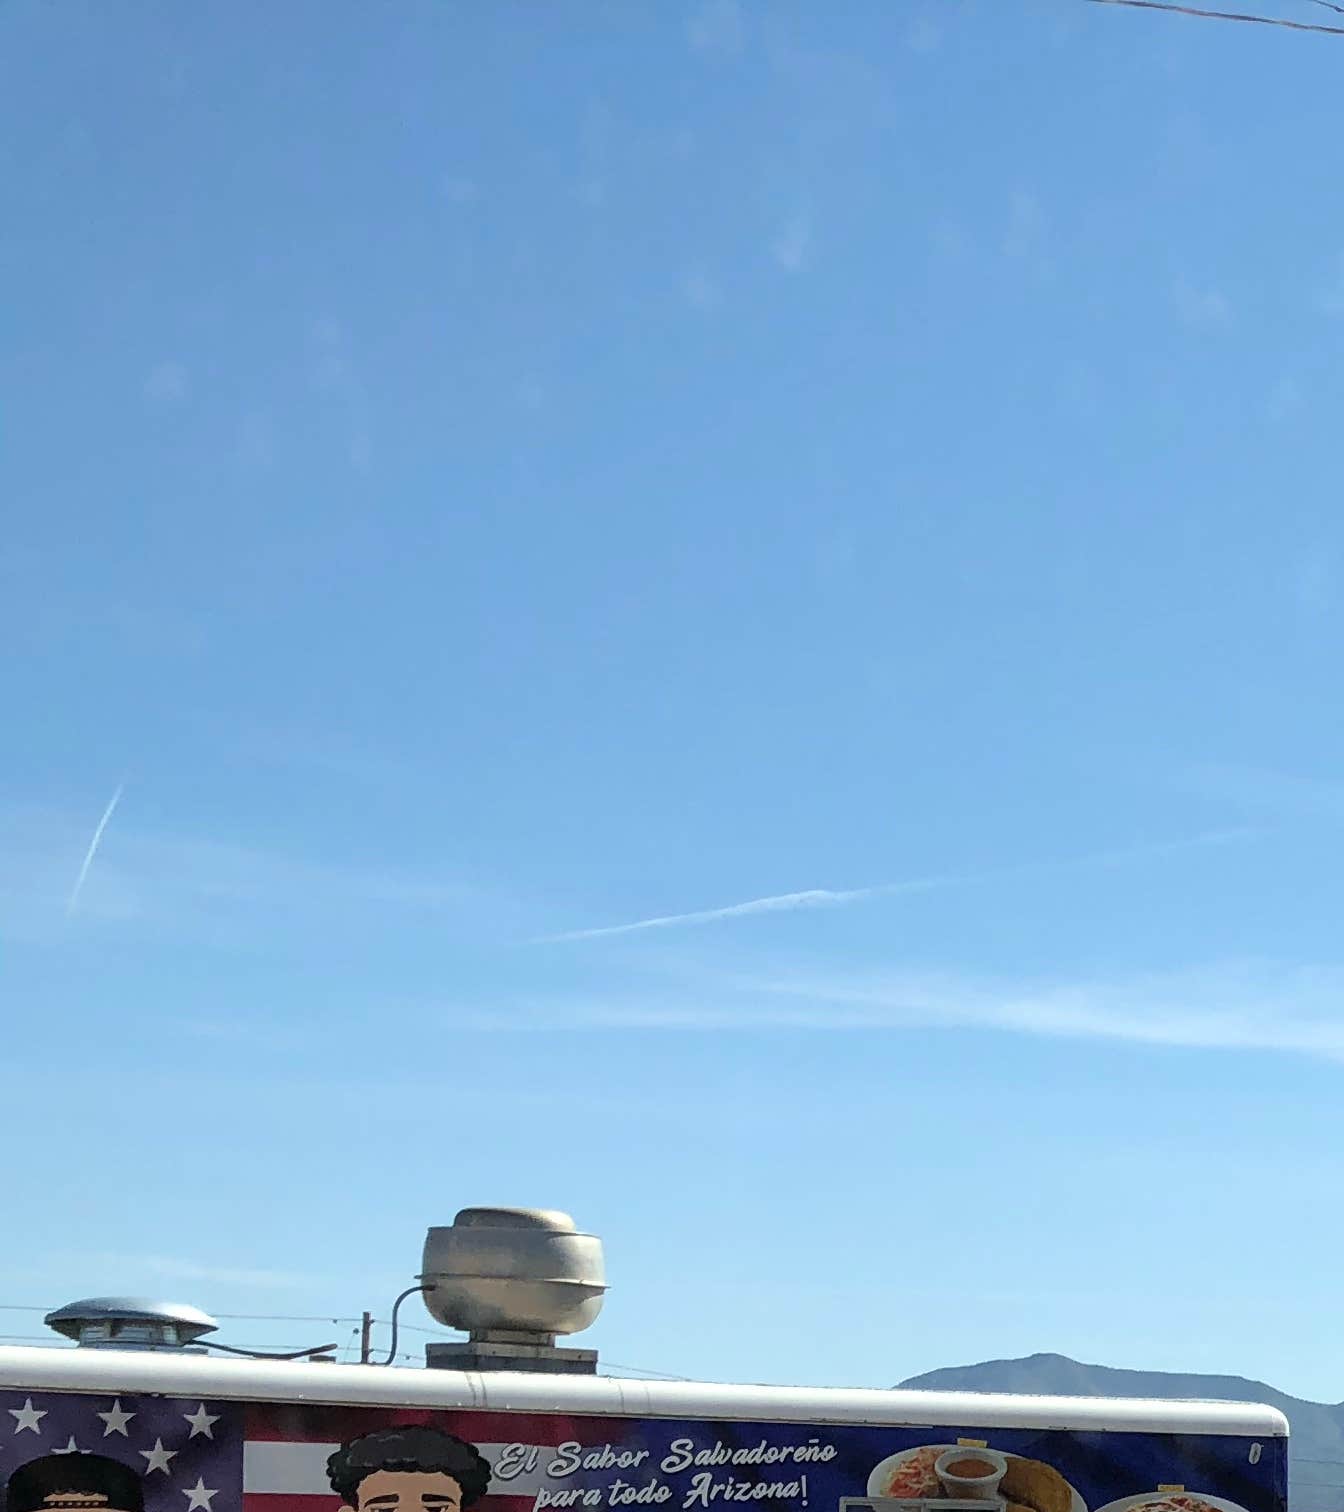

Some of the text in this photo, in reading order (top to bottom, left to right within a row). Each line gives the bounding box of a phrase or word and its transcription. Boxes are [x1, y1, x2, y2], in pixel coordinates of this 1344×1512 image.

[494, 1438, 838, 1479] El Sabor Salvadoreño
[608, 1479, 672, 1506] todo
[683, 1472, 809, 1508] Arizona!
